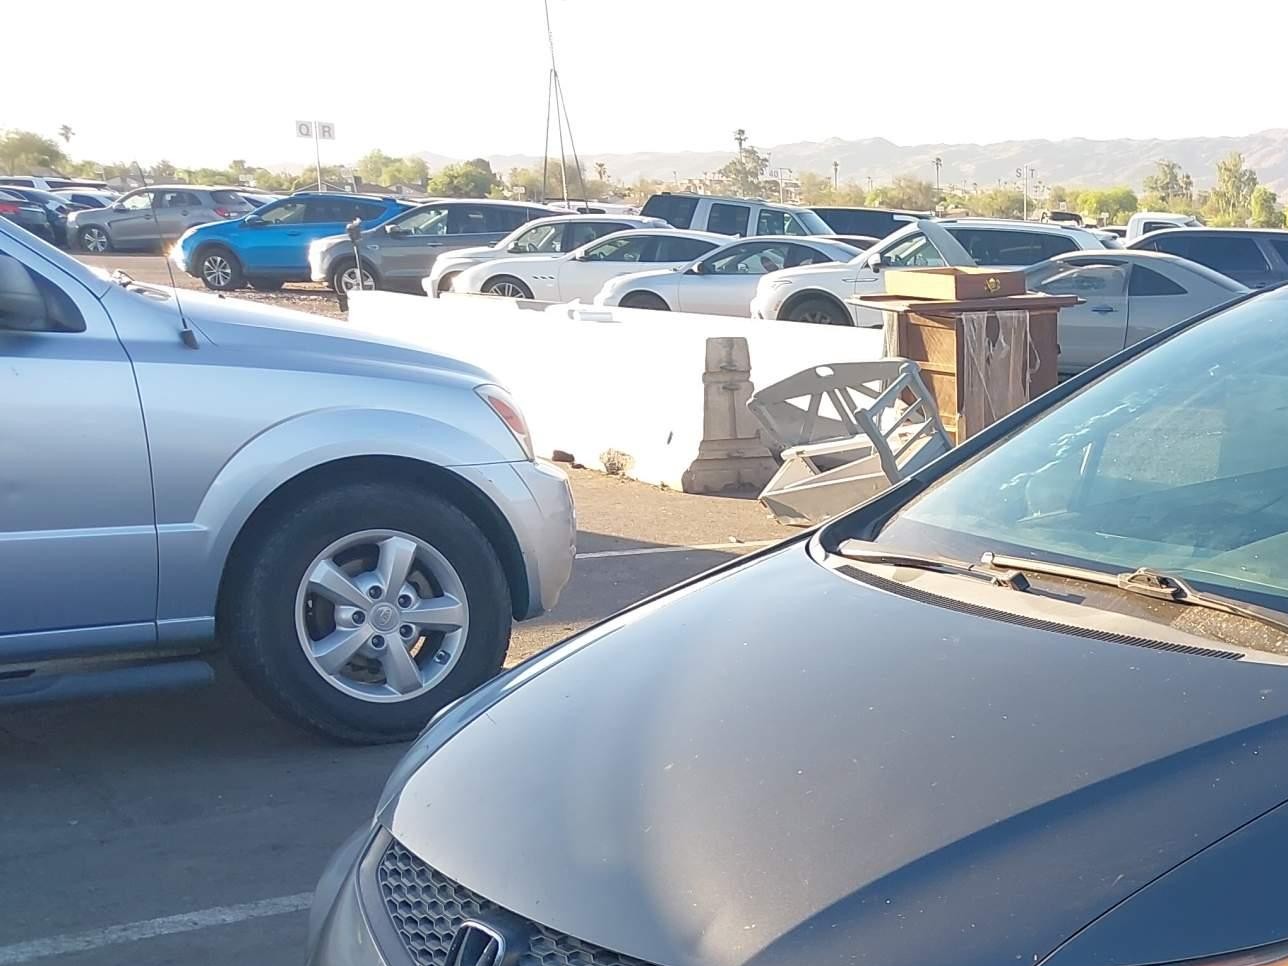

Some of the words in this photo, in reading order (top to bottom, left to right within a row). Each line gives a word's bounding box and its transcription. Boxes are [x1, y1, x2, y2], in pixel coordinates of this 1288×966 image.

[298, 123, 310, 136] Q
[321, 125, 332, 138] R
[1015, 167, 1022, 178] S
[1029, 168, 1036, 178] T
